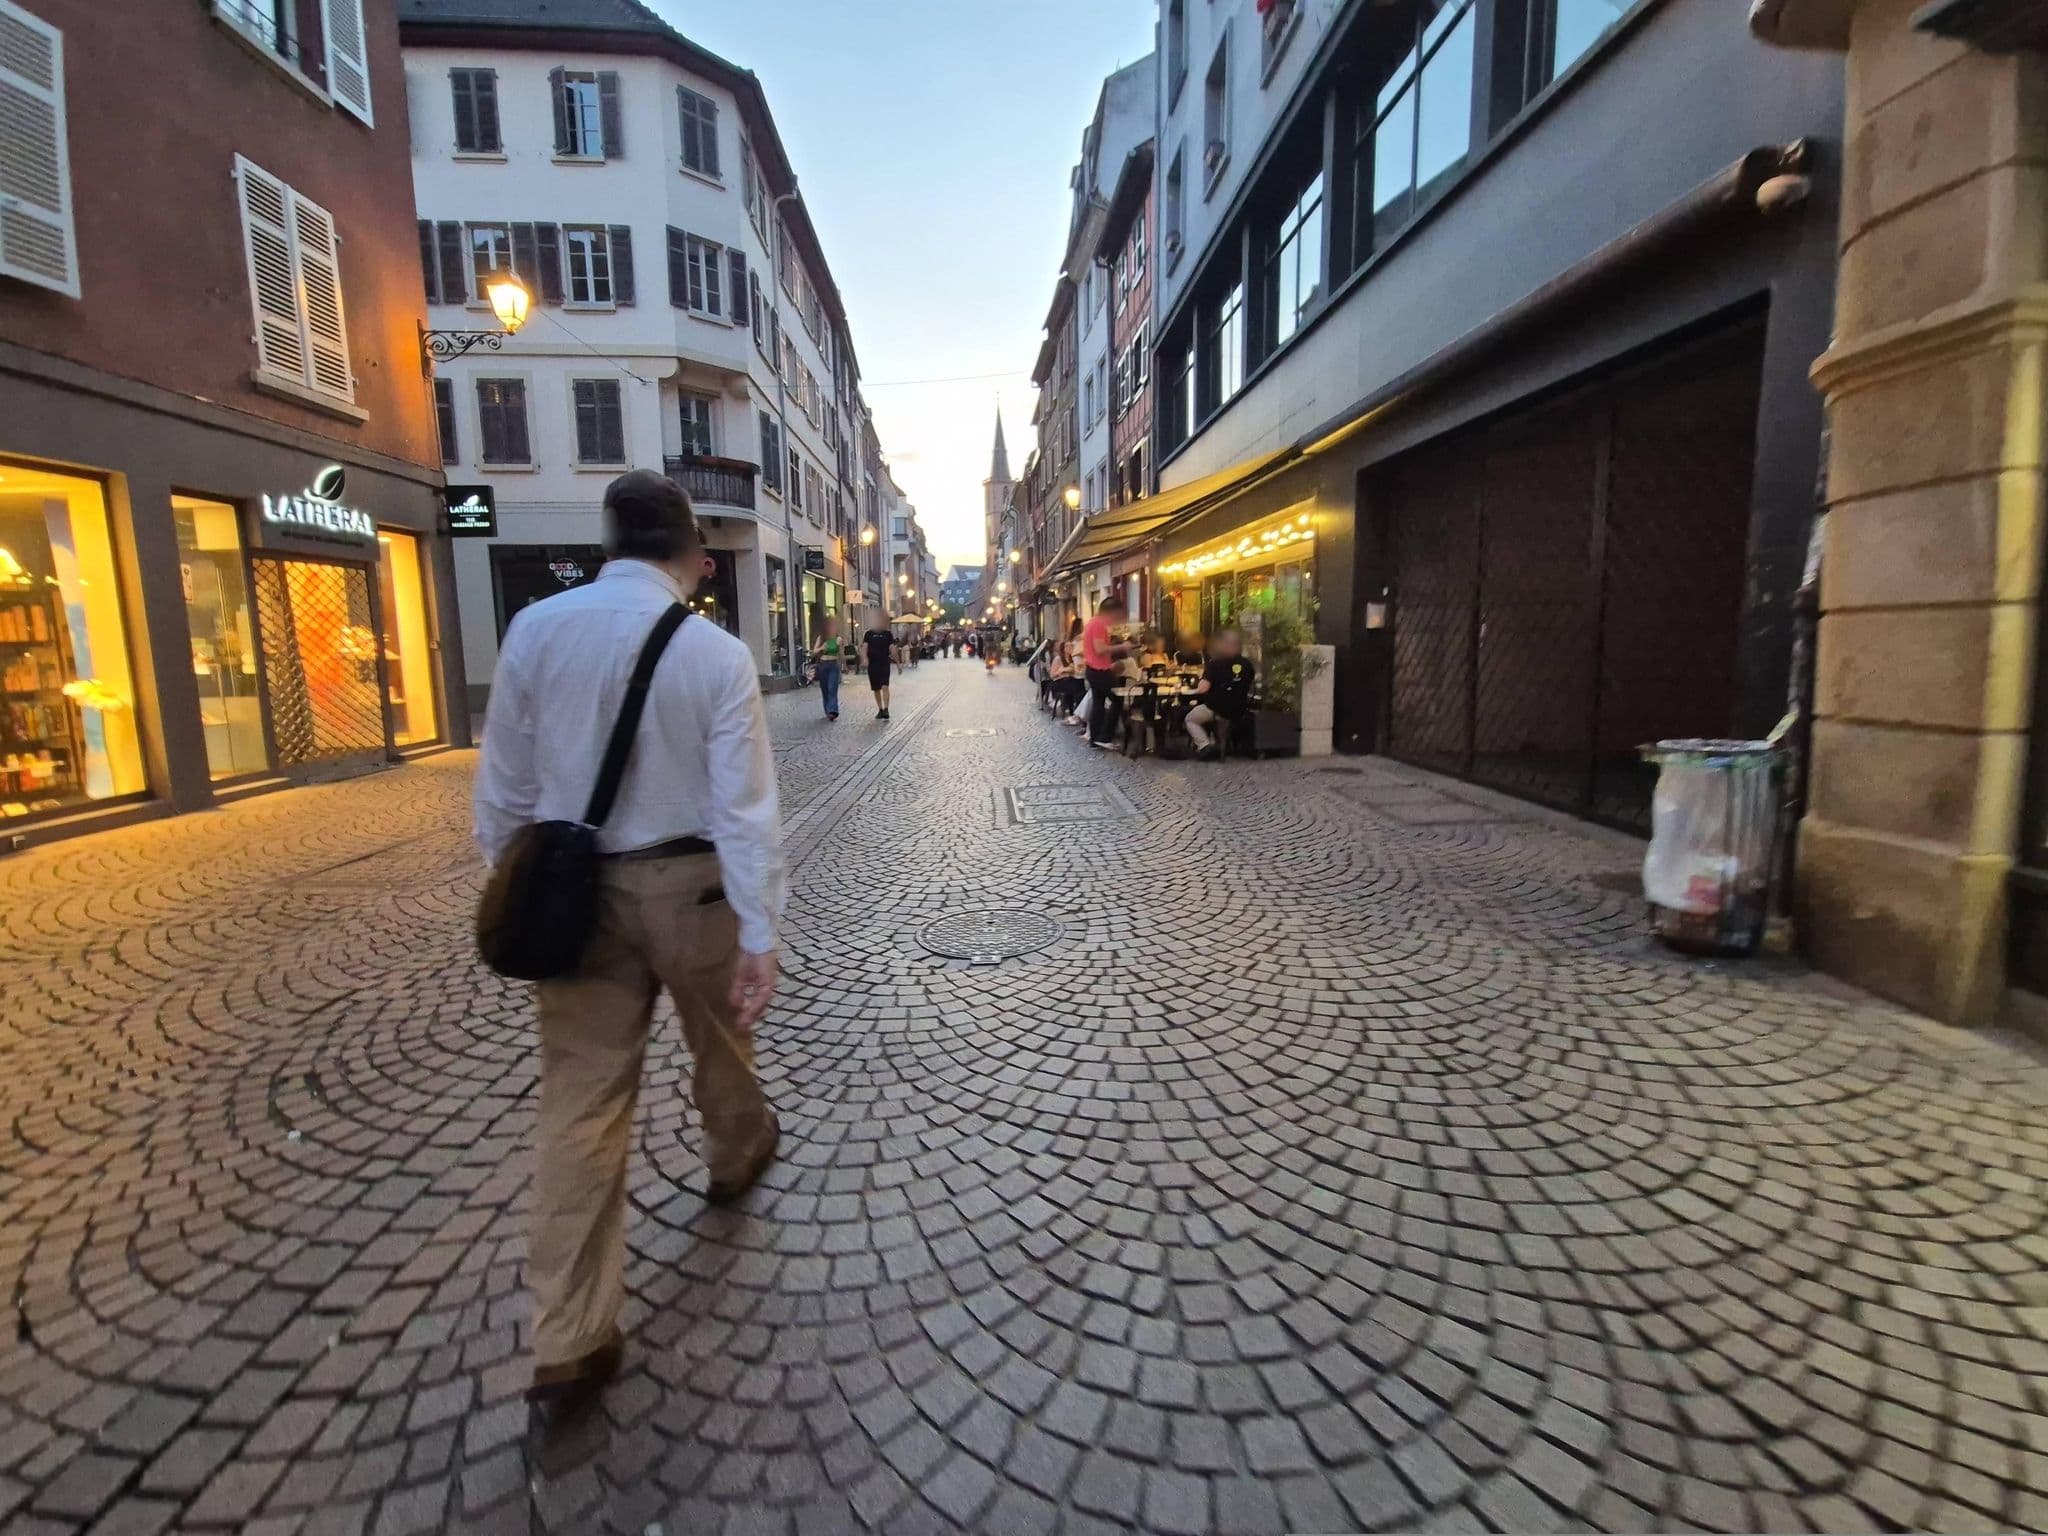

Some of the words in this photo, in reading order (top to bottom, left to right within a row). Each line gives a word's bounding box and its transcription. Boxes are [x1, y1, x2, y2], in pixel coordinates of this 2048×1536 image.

[449, 505, 489, 514] LATHERAL
[262, 494, 375, 536] LATHERAL
[549, 562, 574, 571] GOOD
[556, 569, 584, 578] VIBES
